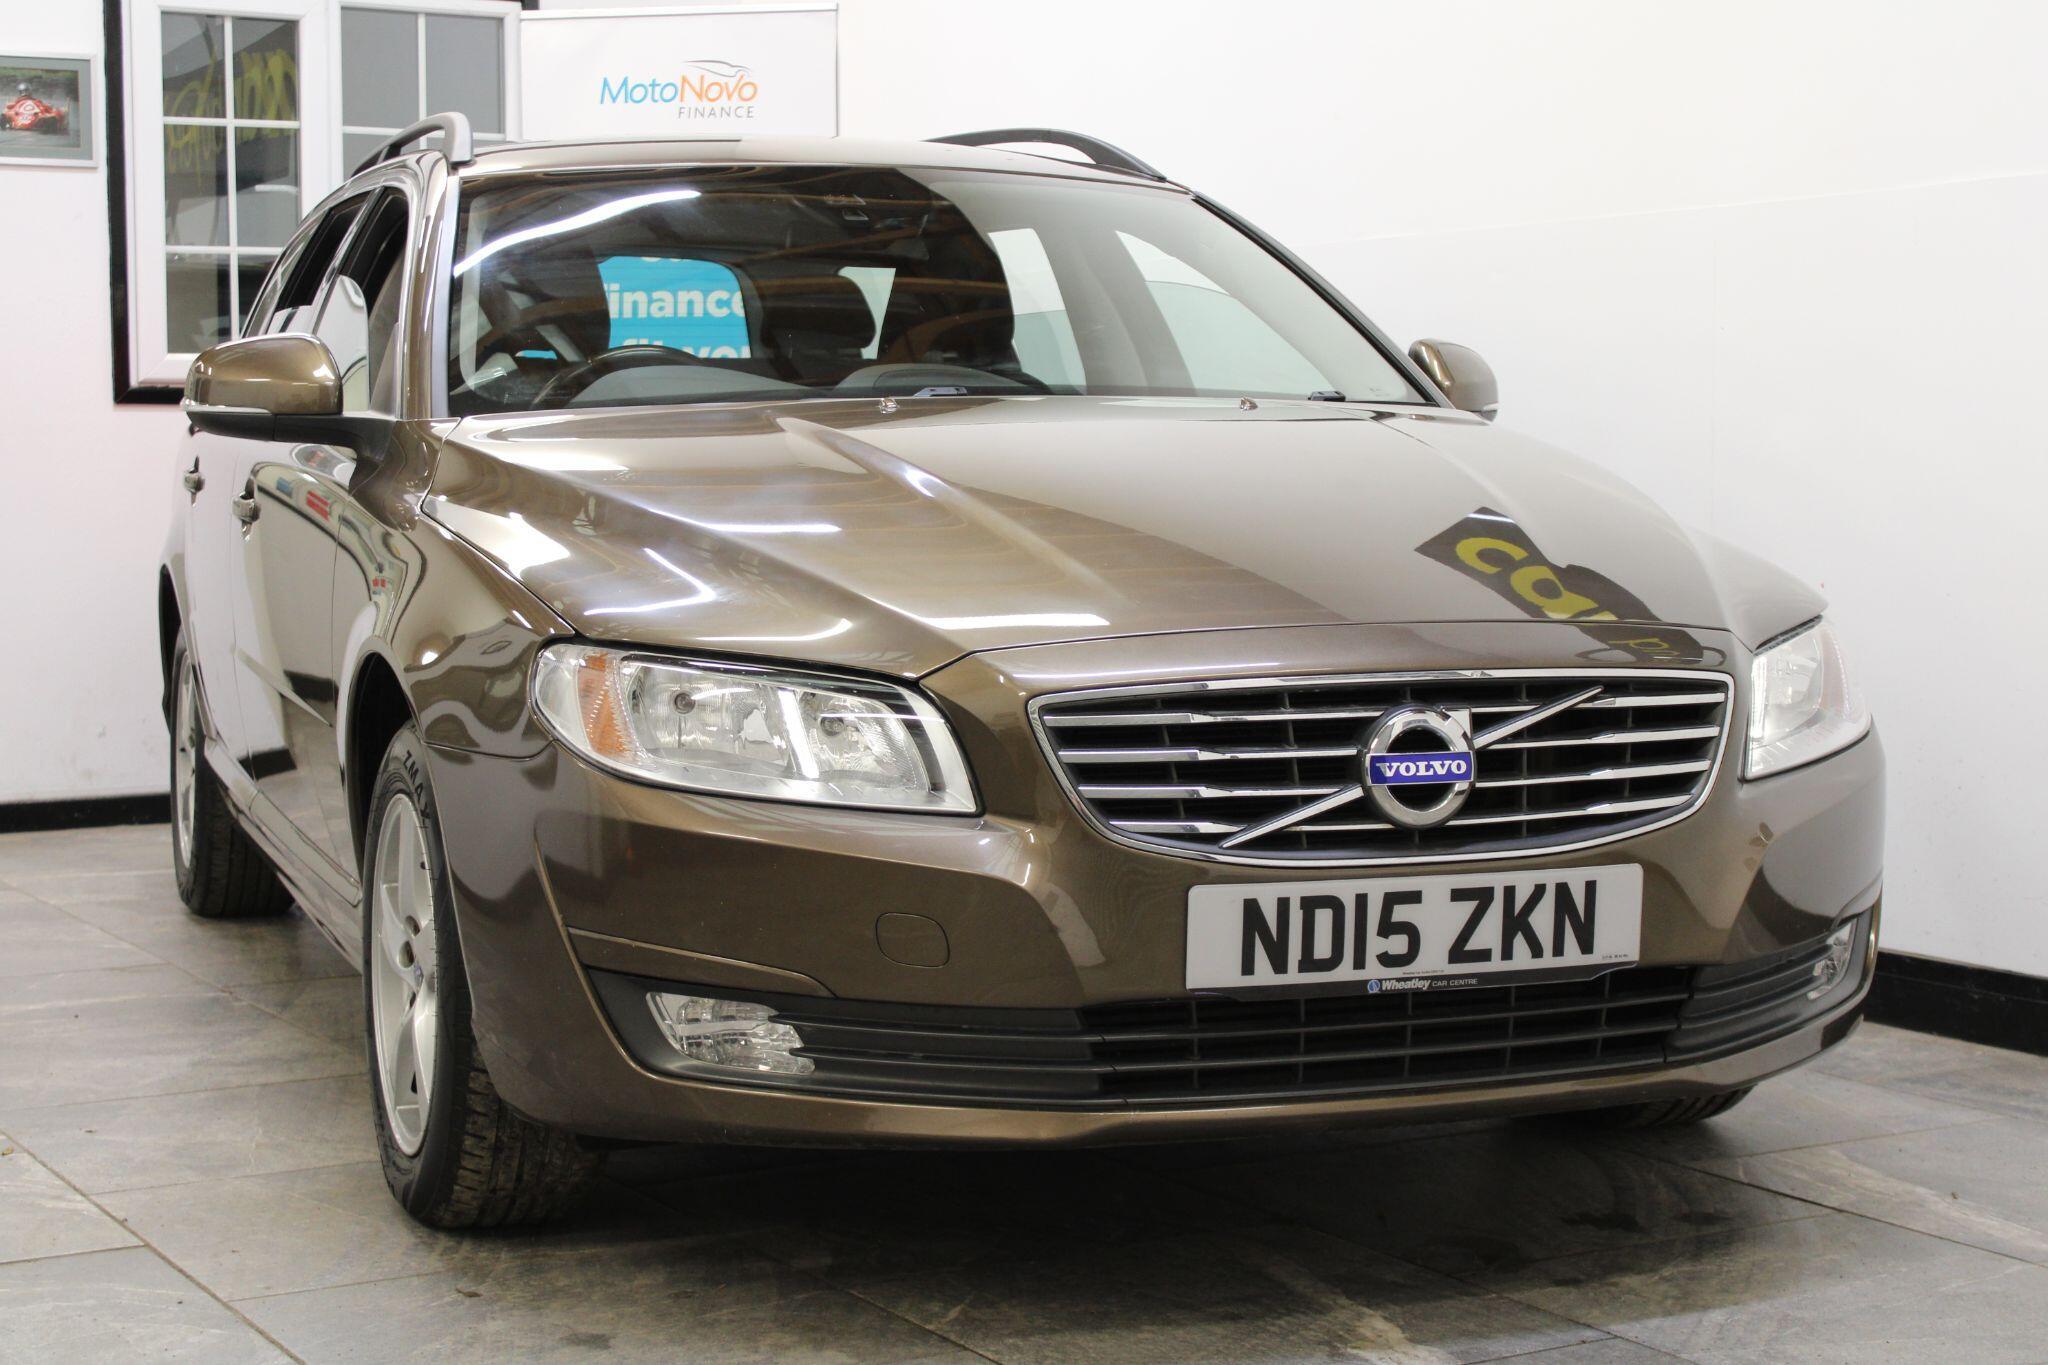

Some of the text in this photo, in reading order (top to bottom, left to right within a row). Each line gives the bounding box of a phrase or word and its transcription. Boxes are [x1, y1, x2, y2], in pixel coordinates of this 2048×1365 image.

[600, 75, 758, 105] MotoNovo
[678, 105, 755, 119] FINANCE
[1376, 759, 1467, 777] VOLVO
[1241, 879, 1598, 976] ND15 ZKN
[1381, 978, 1478, 992] Wheatley CAR CENTRE
